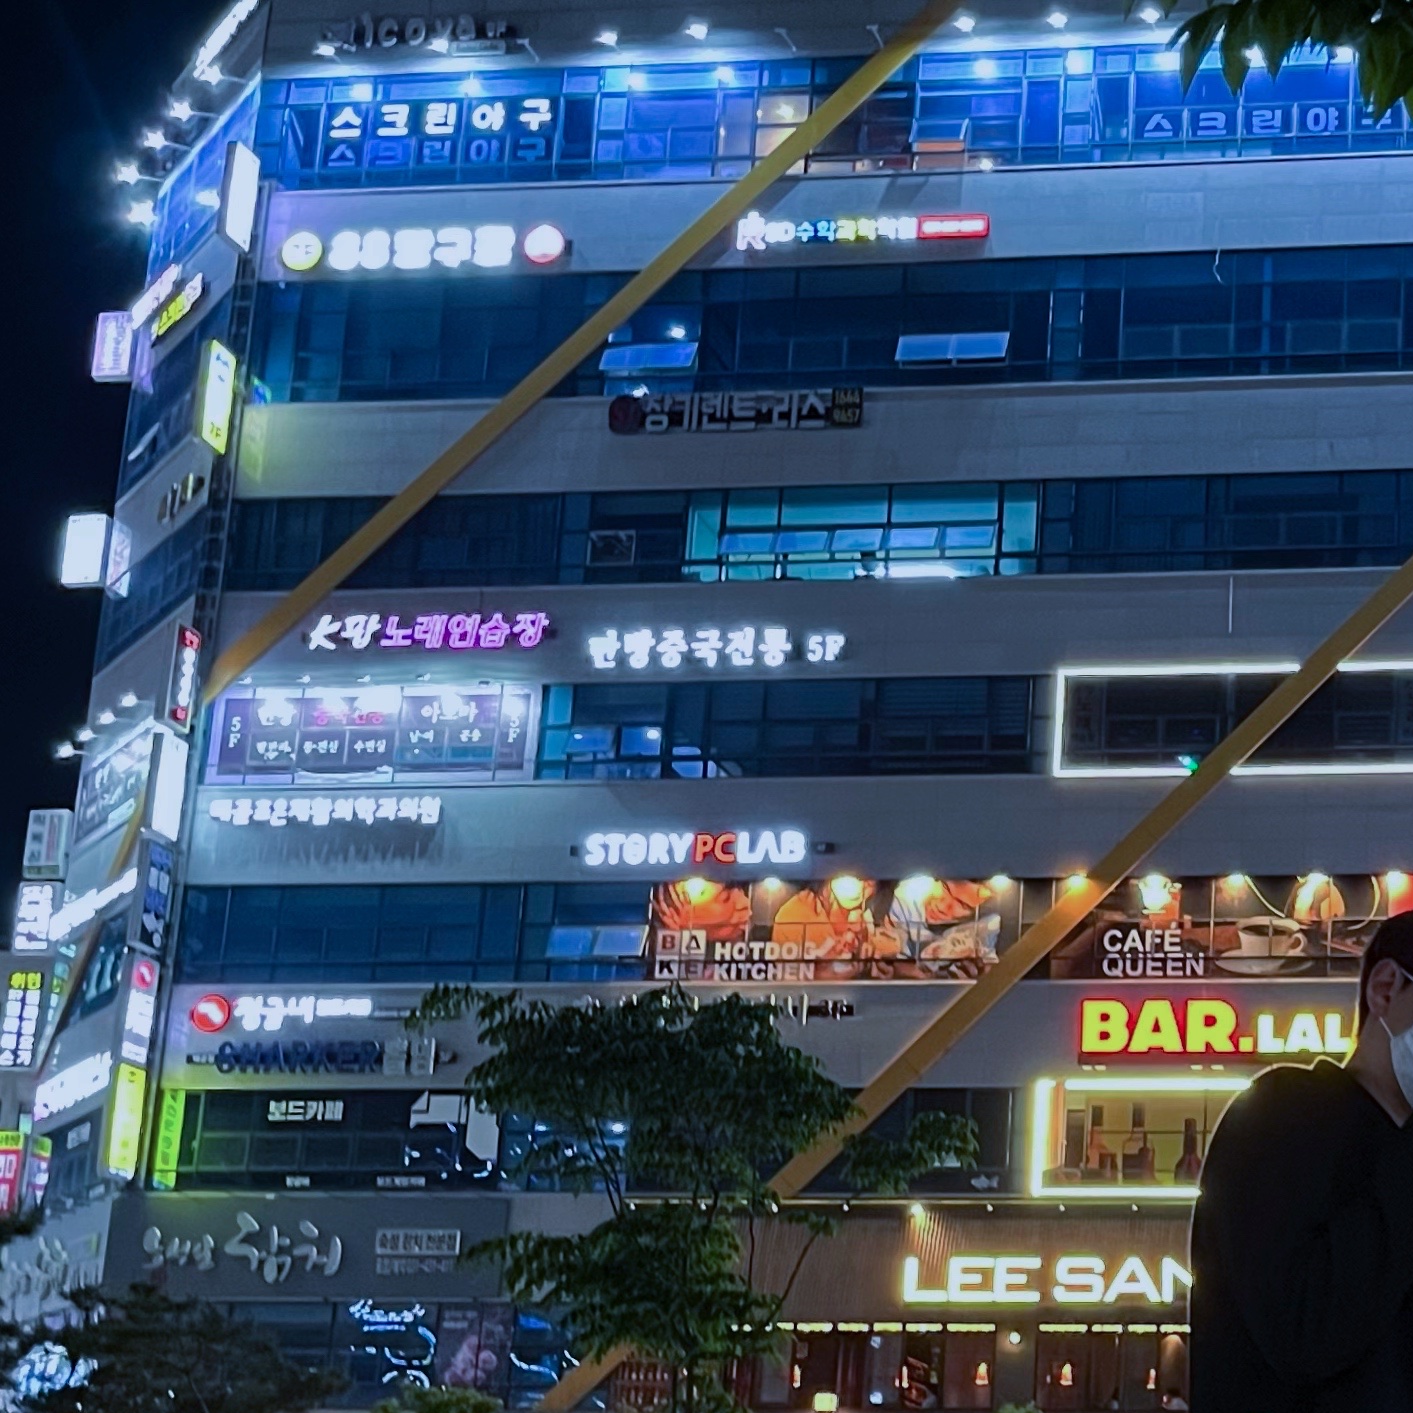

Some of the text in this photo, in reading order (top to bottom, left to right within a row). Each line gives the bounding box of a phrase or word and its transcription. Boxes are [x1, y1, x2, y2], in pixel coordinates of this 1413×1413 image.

[714, 961, 814, 981] KITCHEN
[1102, 953, 1204, 977] QUEEN
[904, 1257, 1041, 1303] LEE
